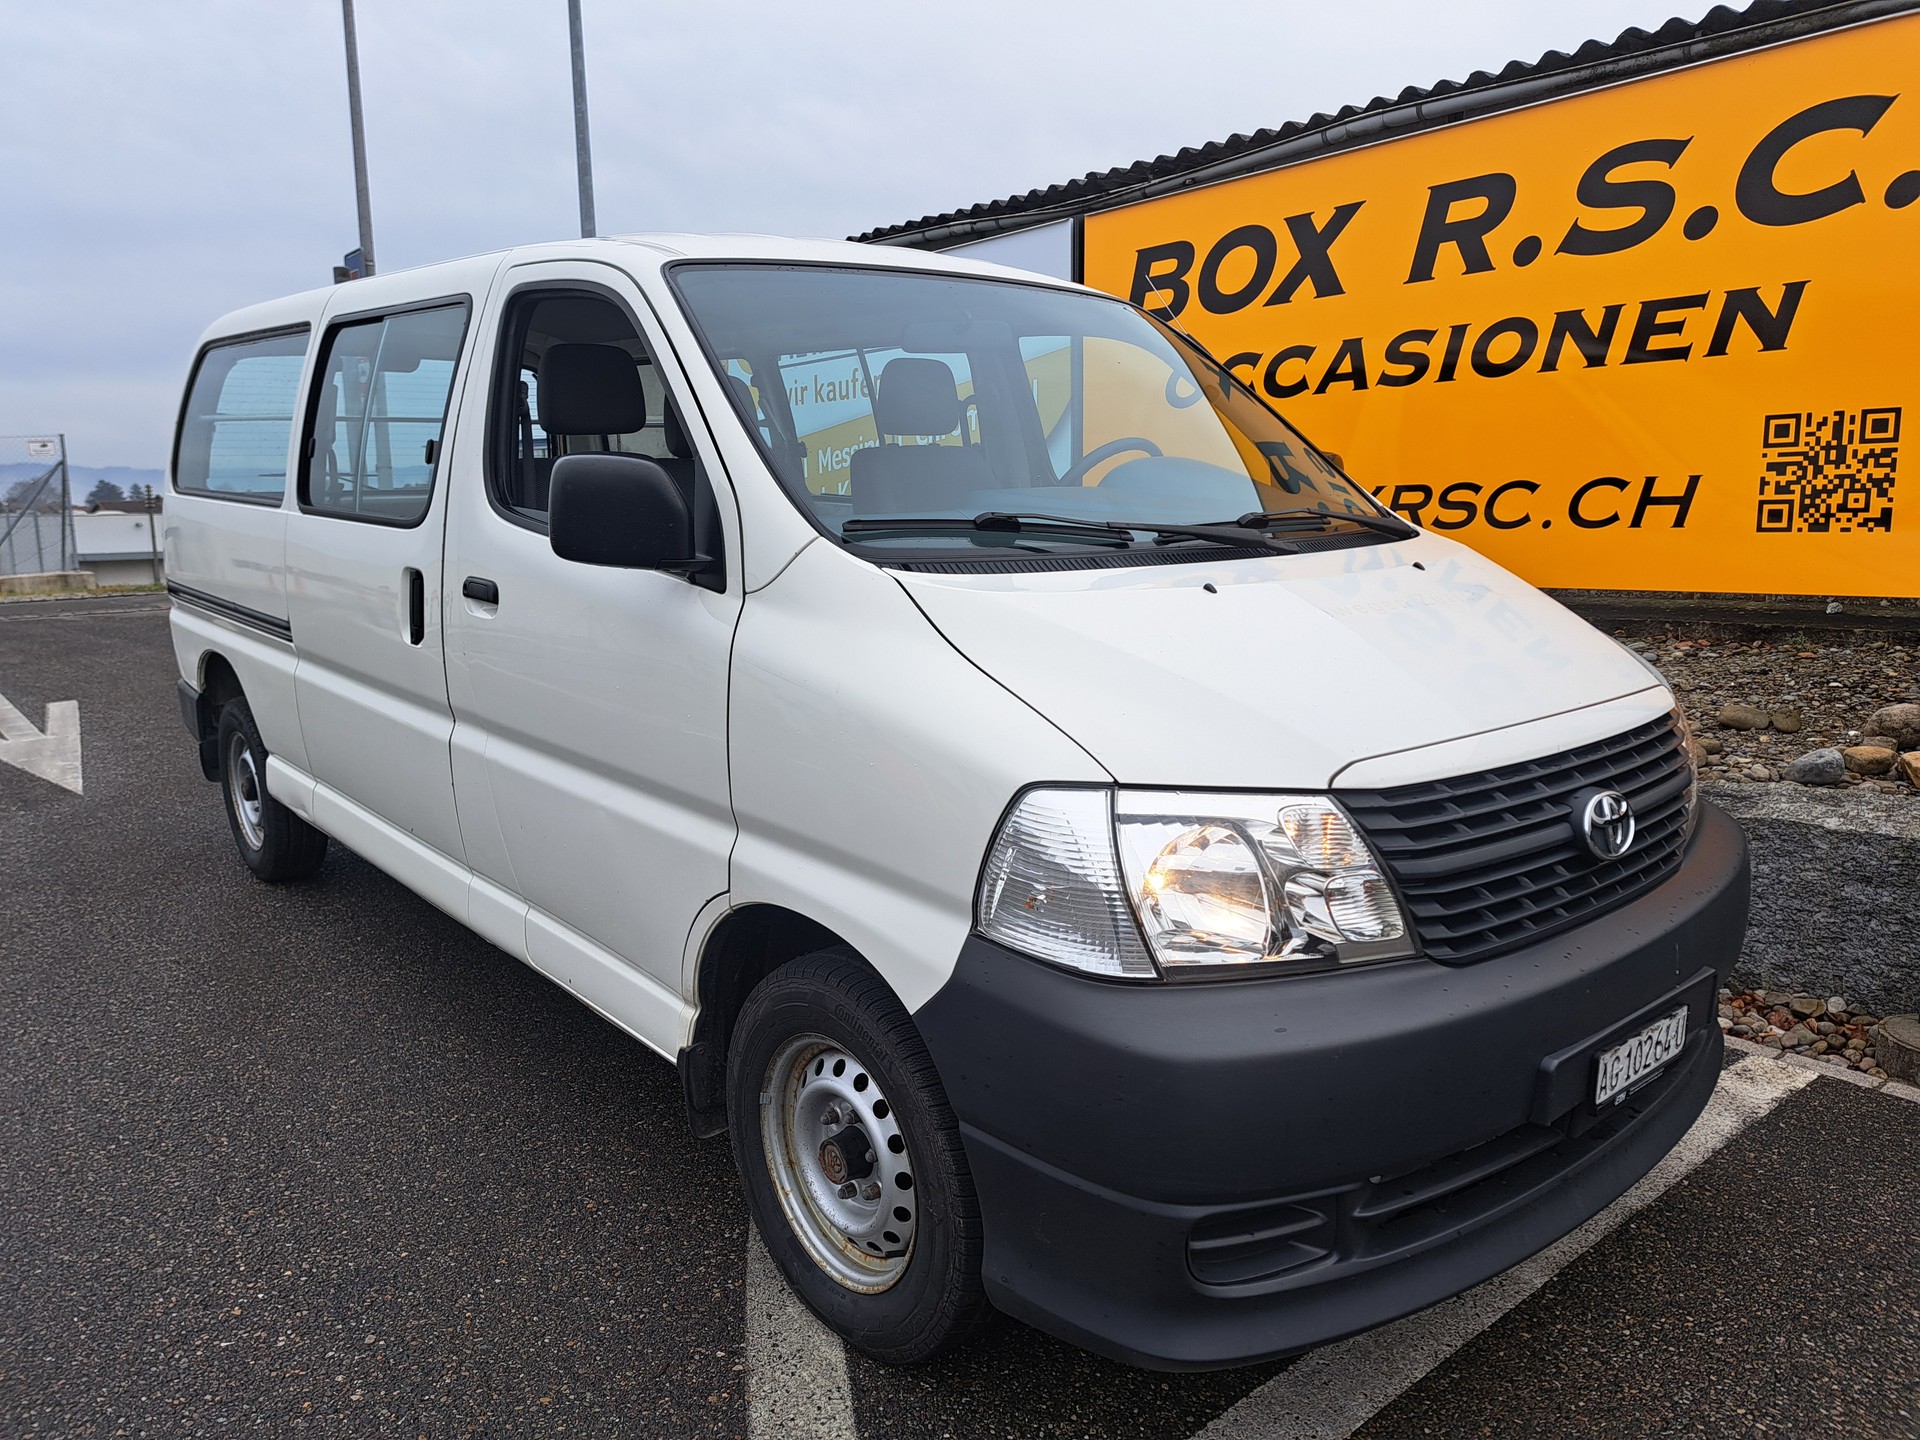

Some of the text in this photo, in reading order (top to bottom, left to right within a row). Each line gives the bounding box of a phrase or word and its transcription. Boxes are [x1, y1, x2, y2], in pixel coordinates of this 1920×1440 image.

[1129, 94, 1920, 322] BOX R.S.C.
[1371, 475, 1701, 531] RSC.CH
